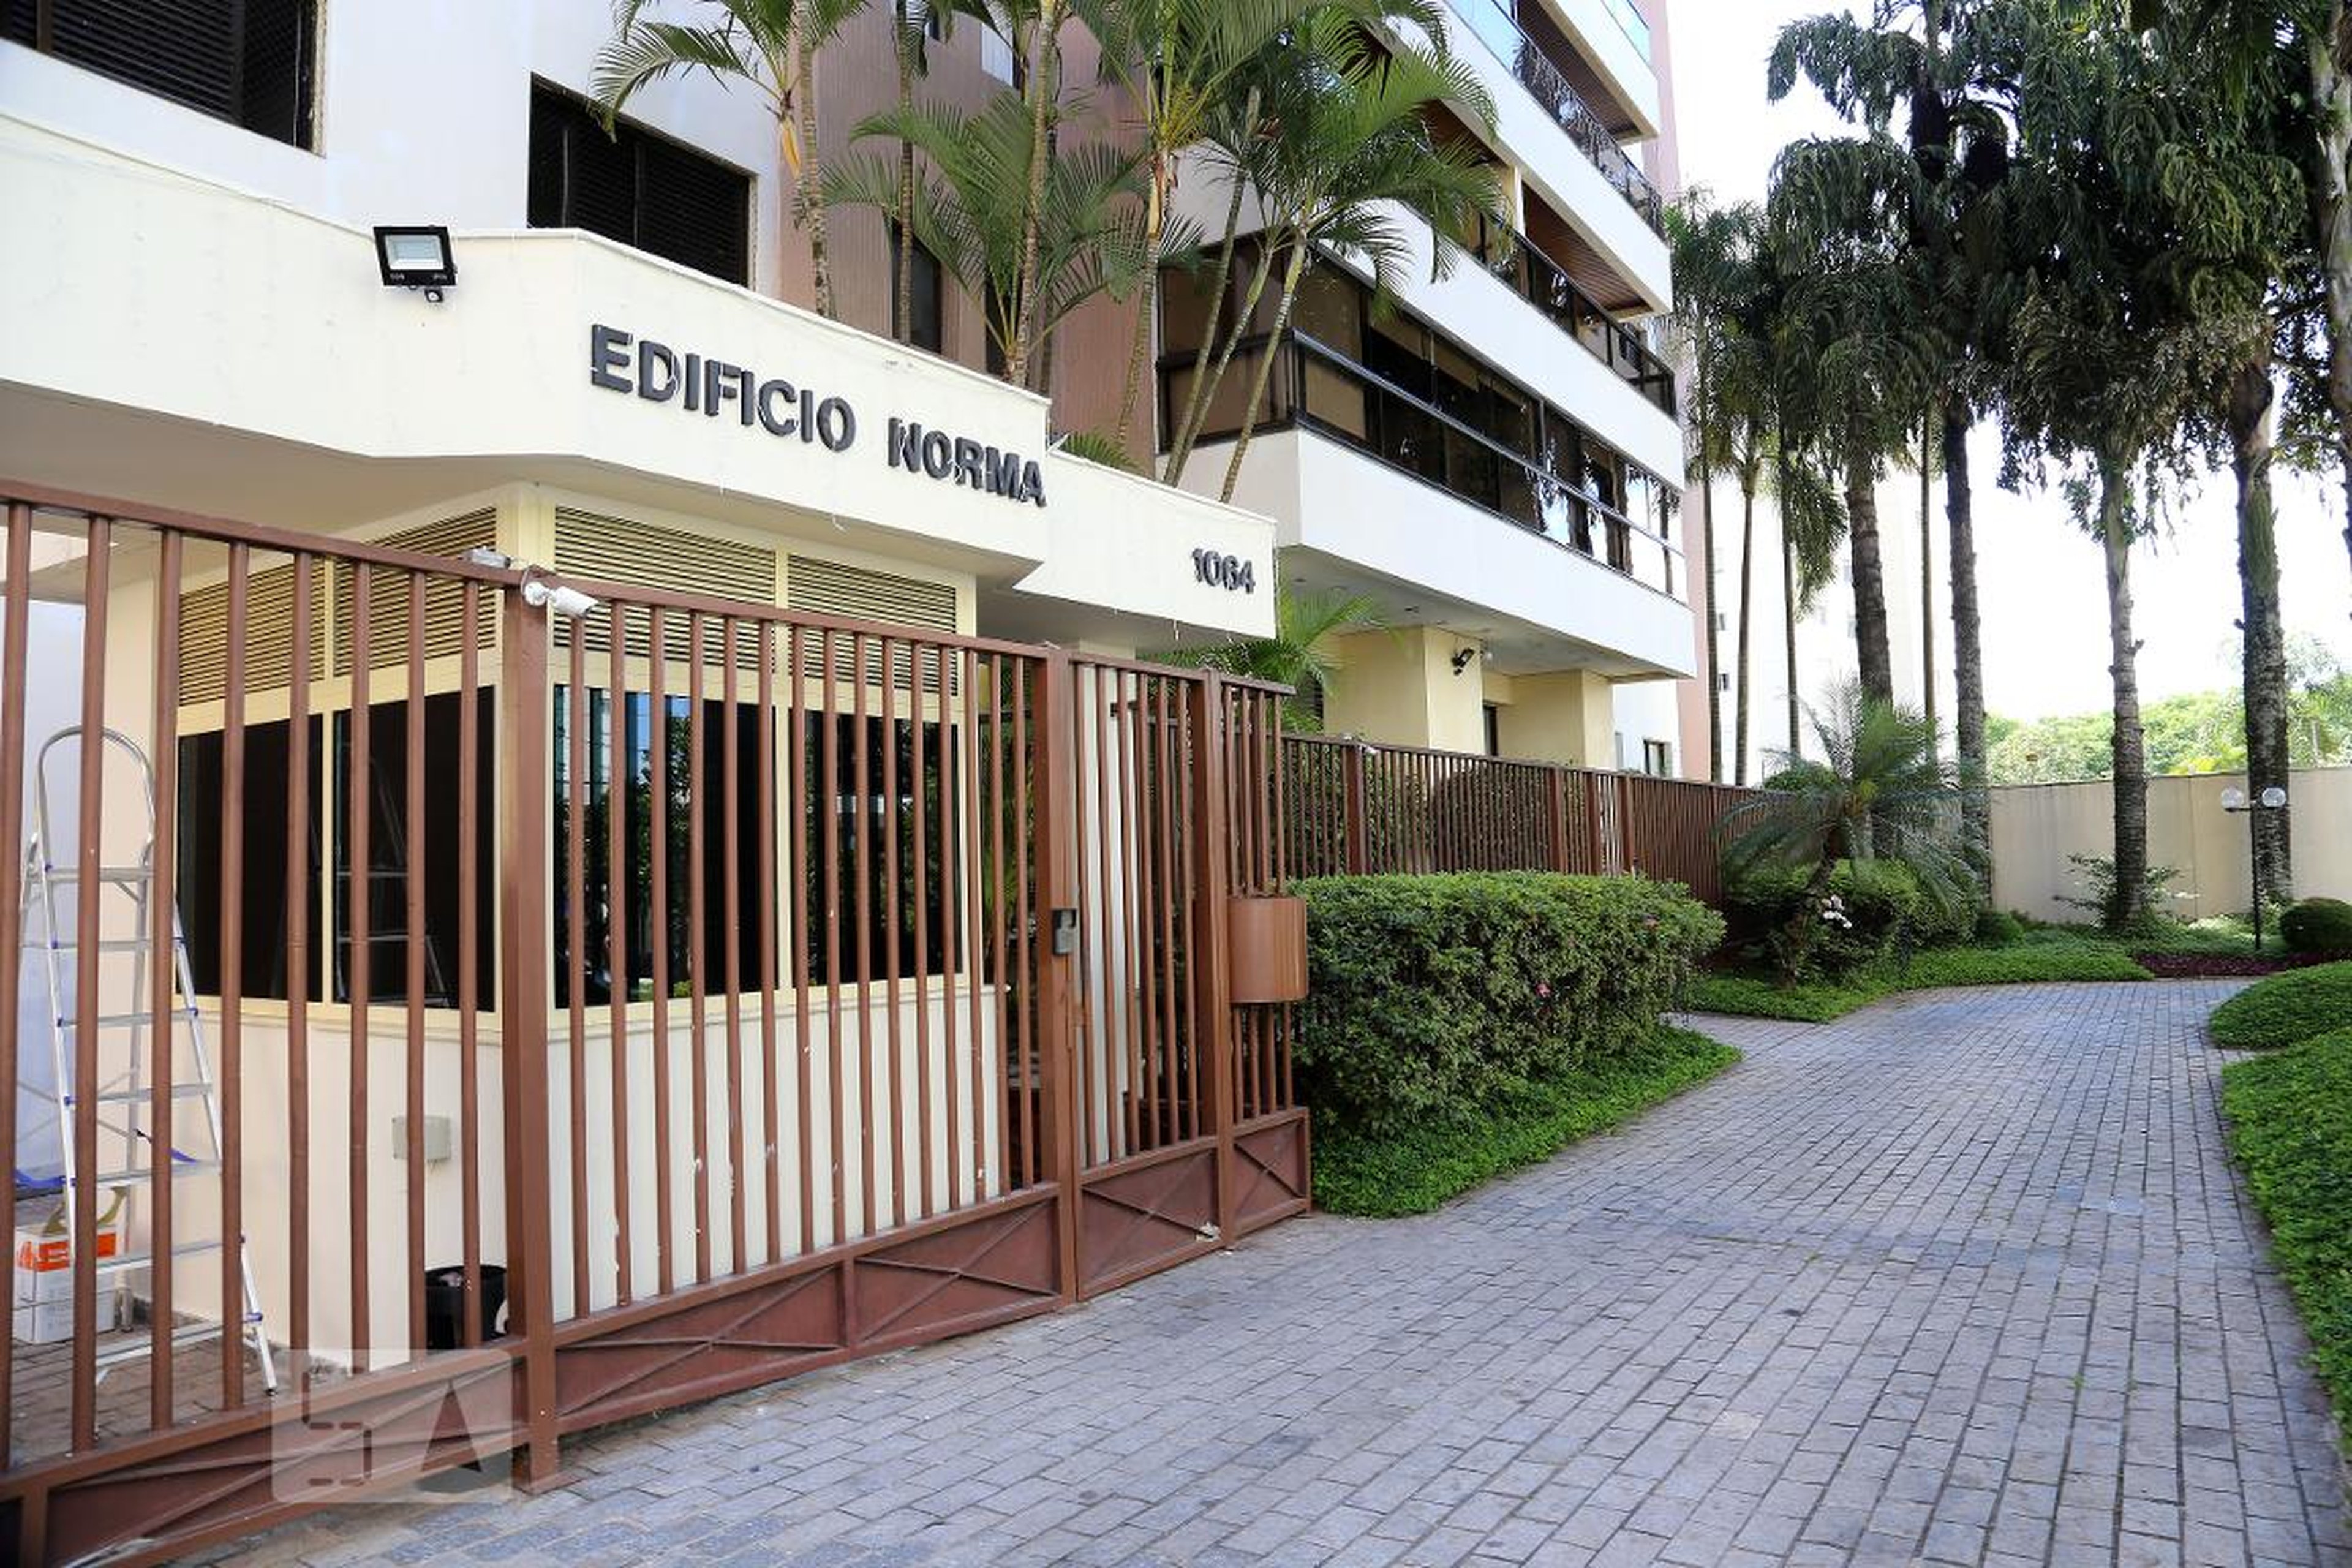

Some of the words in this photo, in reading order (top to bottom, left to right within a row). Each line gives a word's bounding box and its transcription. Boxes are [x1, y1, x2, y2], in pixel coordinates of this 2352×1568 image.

[590, 324, 856, 453] EDIFICIO
[888, 417, 1046, 508] NORMA
[1191, 548, 1256, 594] 1064
